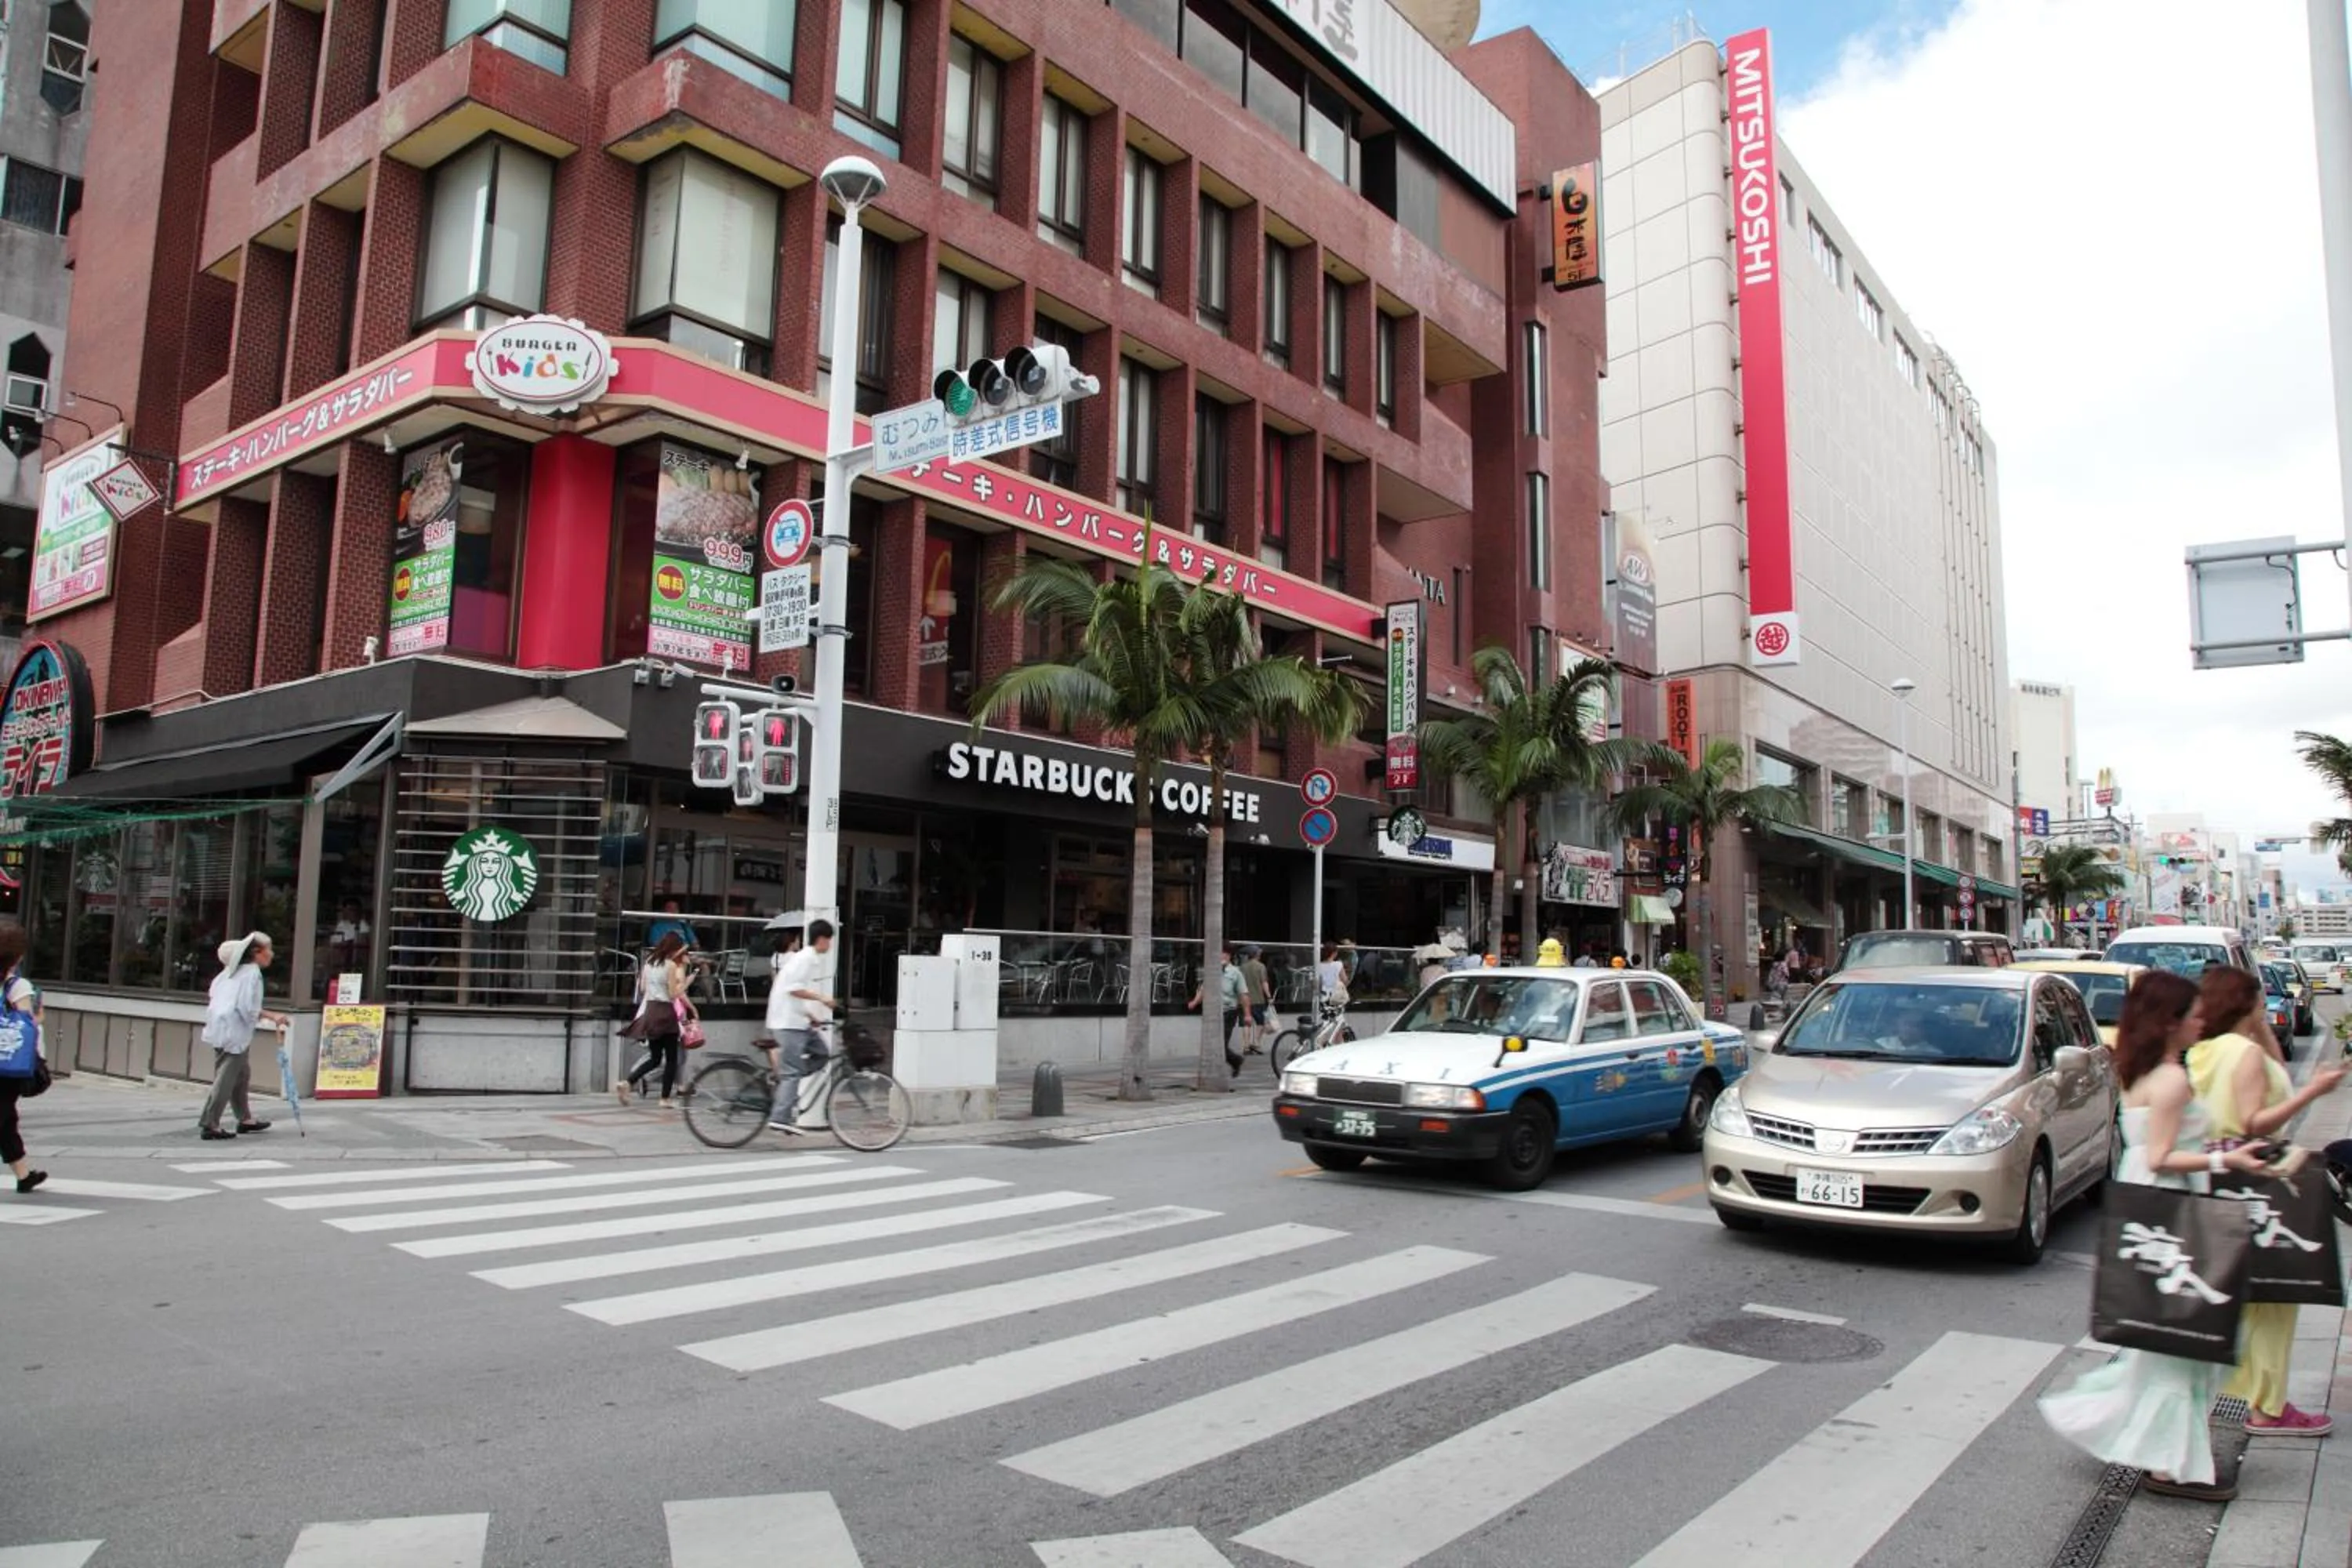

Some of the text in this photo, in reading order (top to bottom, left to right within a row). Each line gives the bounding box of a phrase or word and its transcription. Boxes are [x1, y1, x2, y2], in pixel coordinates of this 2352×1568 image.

[1733, 48, 1772, 285] MITSUKOSHI
[502, 338, 577, 351] BURGER
[953, 405, 1058, 457] 時差式信号機
[665, 450, 711, 474] ステーキ
[689, 566, 753, 589] サラダバー
[948, 742, 1154, 805] STARBUCK
[1811, 1184, 1860, 1204] 66-15
